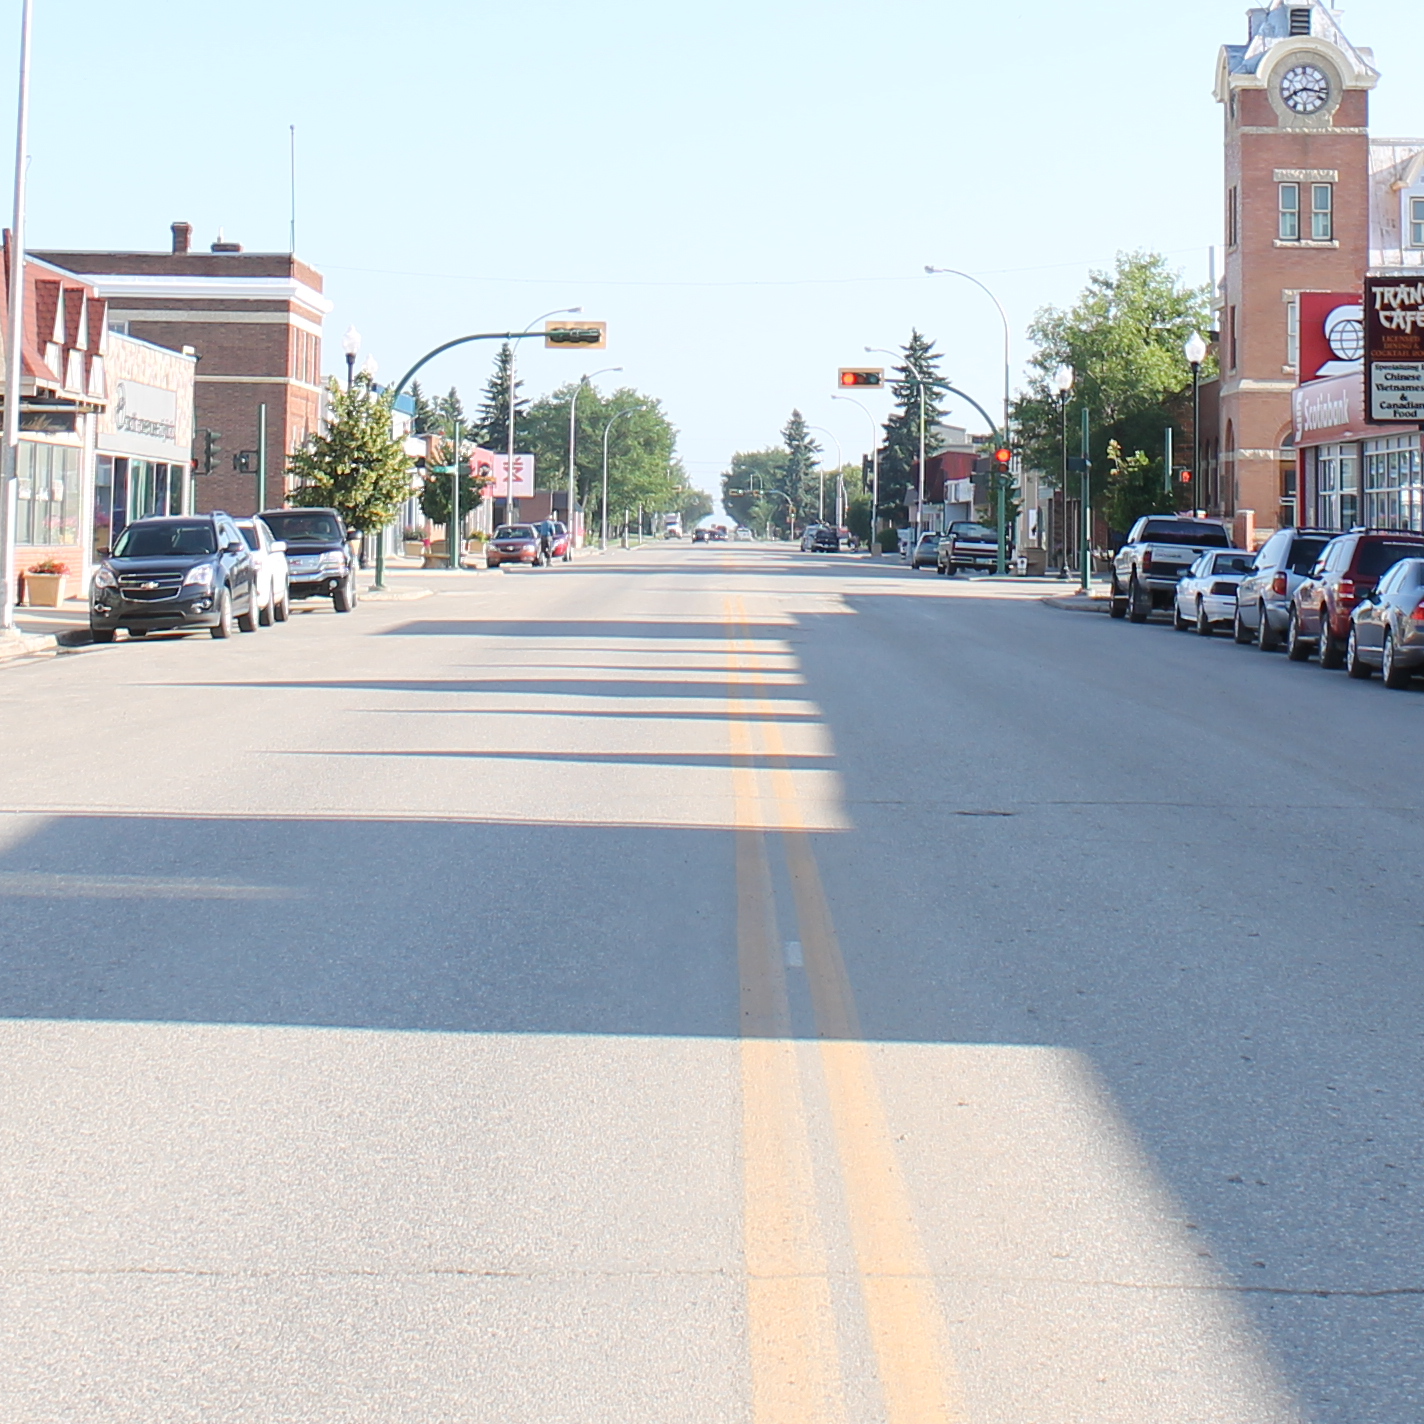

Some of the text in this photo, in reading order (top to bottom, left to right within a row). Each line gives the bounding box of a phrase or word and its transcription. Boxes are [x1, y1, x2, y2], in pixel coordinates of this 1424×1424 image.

[1384, 372, 1422, 381] Chinese
[1304, 389, 1350, 432] Scotiabank
[1393, 409, 1418, 418] Food
